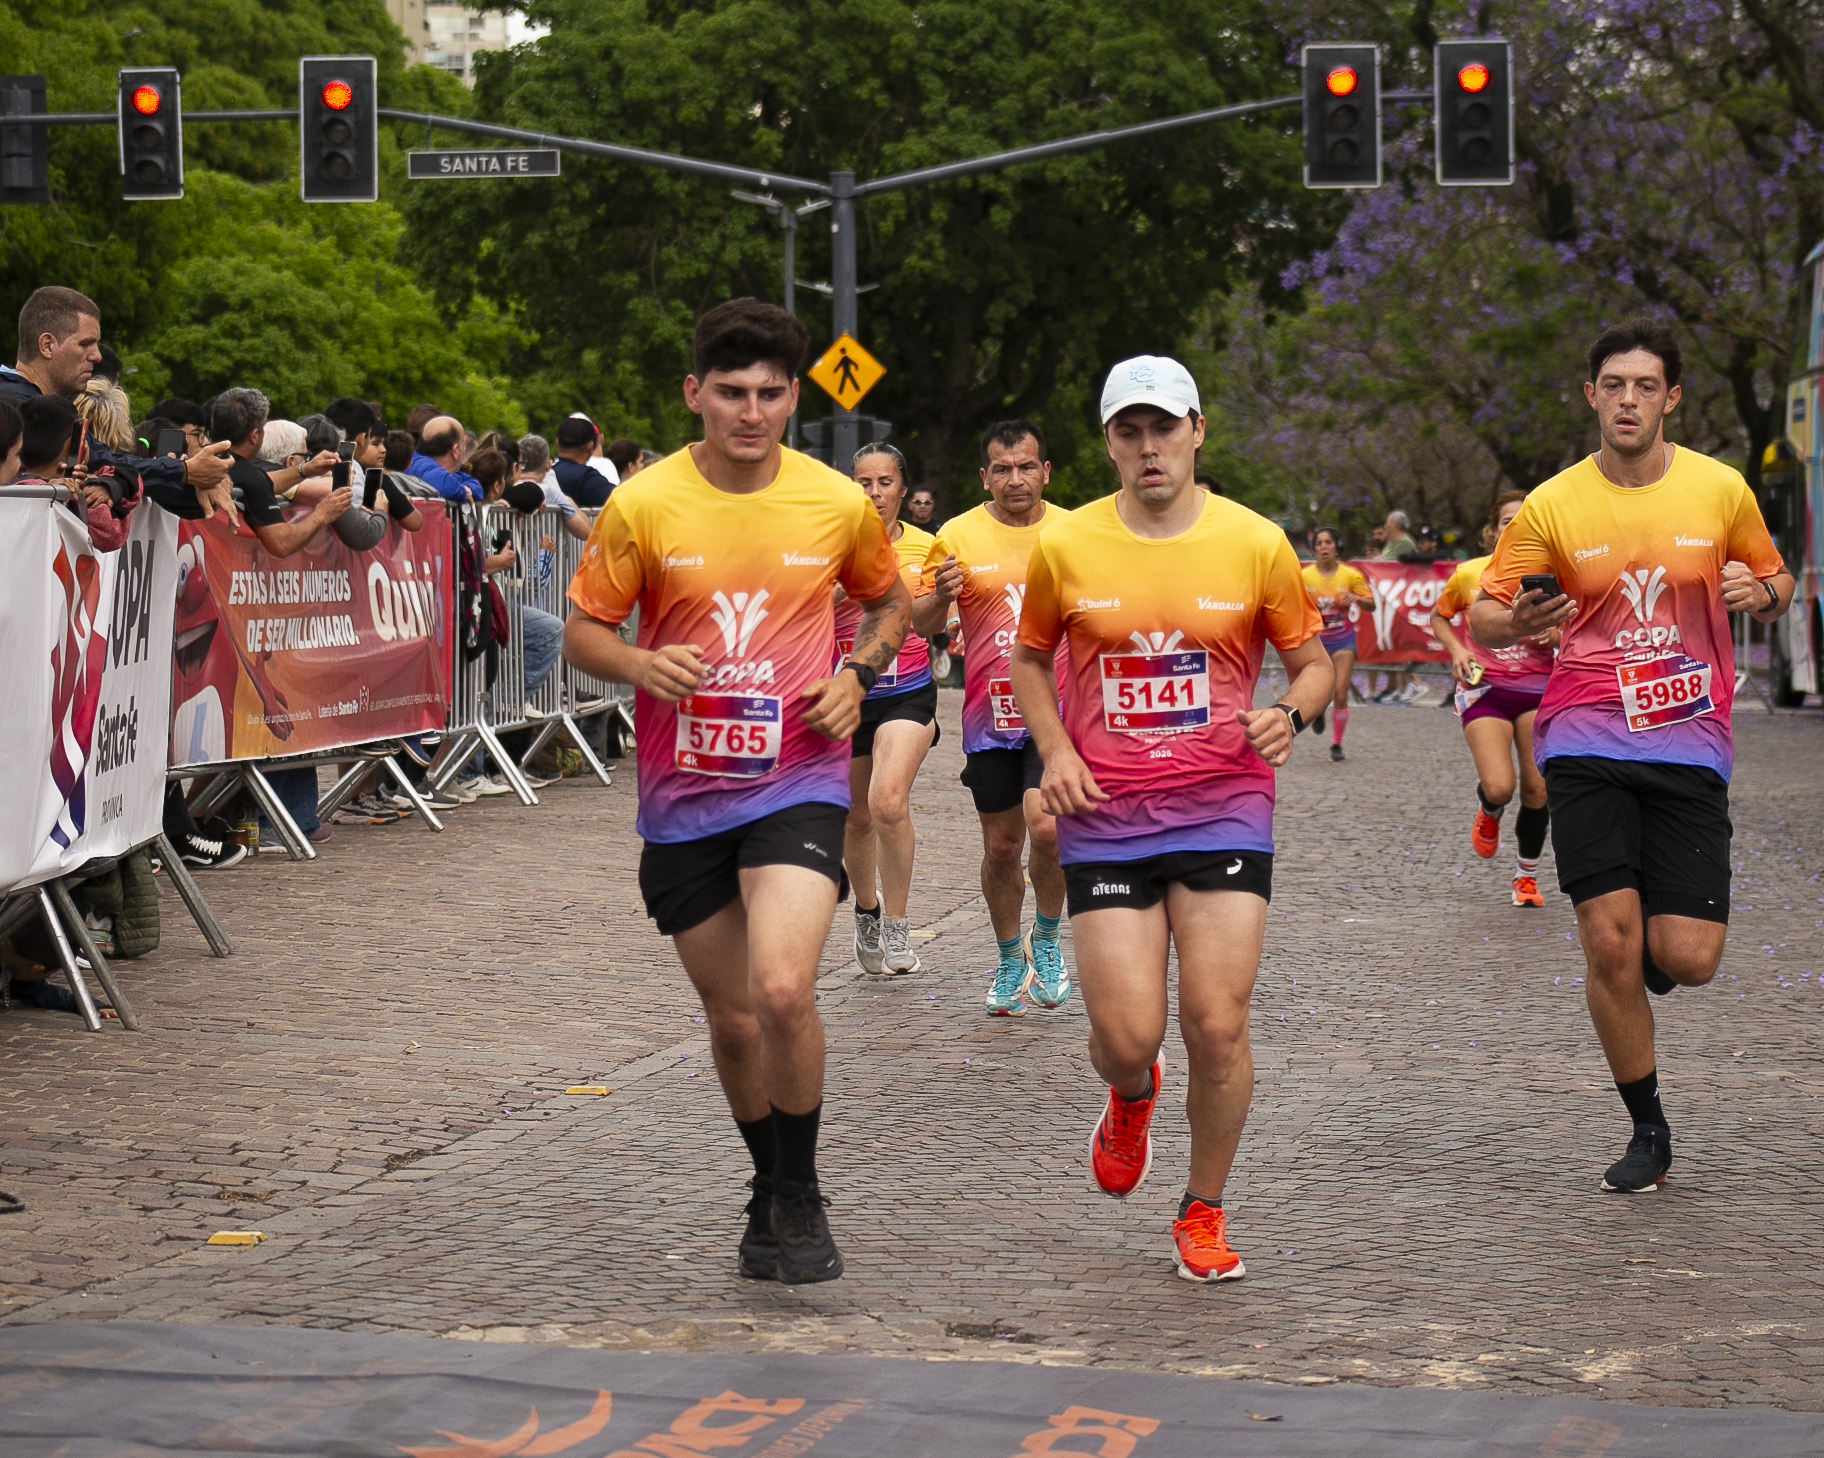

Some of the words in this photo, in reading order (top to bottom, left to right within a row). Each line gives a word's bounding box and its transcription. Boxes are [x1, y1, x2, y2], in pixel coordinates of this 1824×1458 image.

[440, 156, 500, 173] SANTA
[507, 155, 529, 172] FE
[1673, 533, 1714, 548] VANDALIA
[696, 555, 704, 566] 6
[781, 551, 830, 567] VANDALIA
[229, 562, 268, 605] ESTÁS
[269, 571, 277, 604] A
[277, 571, 300, 604] SEIS
[302, 562, 351, 603] NÚMEROS
[1404, 579, 1447, 607] COP
[103, 539, 155, 673] OPA
[1113, 597, 1121, 608] 6
[1196, 595, 1245, 611] VANDALIA
[246, 619, 265, 653] DE
[264, 618, 286, 652] SER
[285, 614, 360, 650] MILLONARIO.
[1615, 624, 1682, 650] COPA
[701, 660, 775, 686] COPA
[1173, 664, 1192, 672] Santa
[1118, 679, 1195, 710] 5141
[1635, 674, 1702, 710] 5988
[743, 709, 765, 717] Santa
[765, 709, 774, 717] Fe
[1113, 715, 1129, 726] 4k
[999, 719, 1009, 728] 4k
[1636, 717, 1650, 727] 5k
[96, 704, 128, 777] Santa
[125, 695, 138, 764] Fe
[690, 721, 767, 755] 5765
[683, 754, 698, 767] 4k
[1149, 750, 1172, 759] 2025
[1092, 883, 1131, 896] ATENAS
